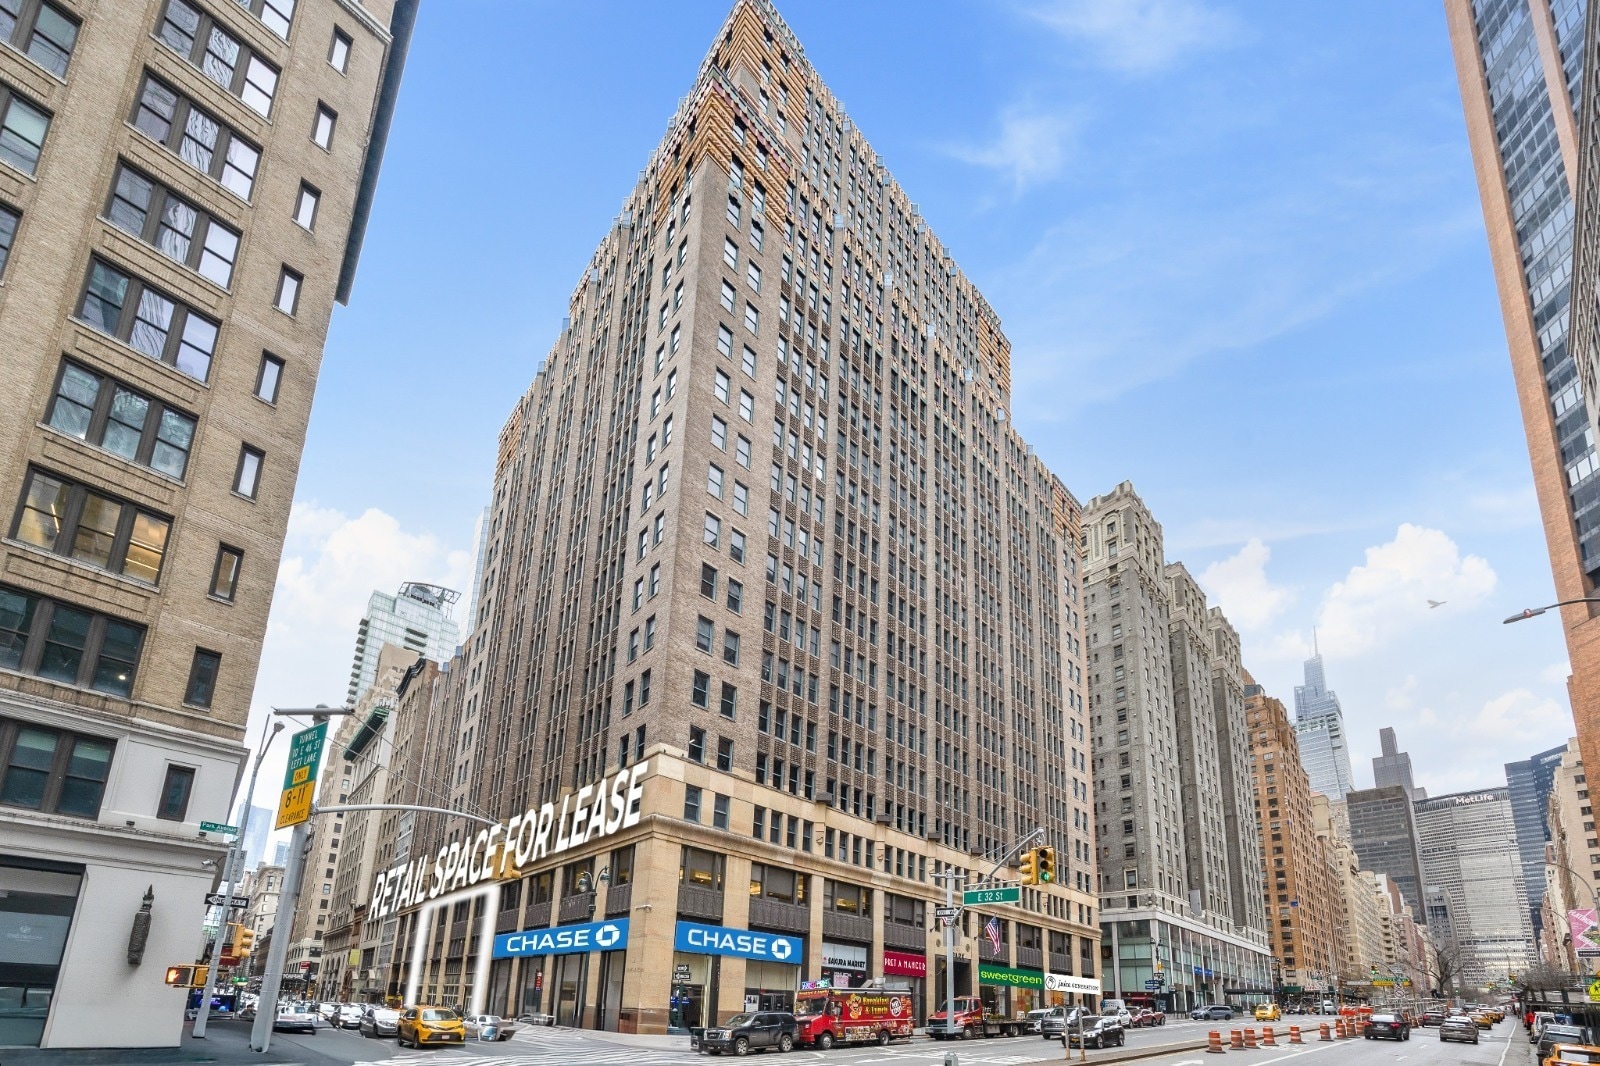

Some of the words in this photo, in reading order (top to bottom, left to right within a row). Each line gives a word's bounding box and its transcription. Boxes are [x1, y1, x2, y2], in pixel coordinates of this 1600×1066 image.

[303, 751, 317, 766] LANE
[294, 769, 308, 782] ONLY
[1455, 793, 1494, 805] MetLife
[202, 821, 215, 829] Park
[216, 824, 237, 833] Avenue
[977, 893, 982, 902] E
[985, 892, 994, 901] 32
[506, 929, 591, 952] CHASE
[687, 929, 767, 955] CHASE
[828, 957, 846, 967] SAKURA
[847, 959, 866, 969] MARKET
[884, 957, 896, 967] PRET
[898, 959, 902, 967] A
[980, 970, 1043, 985] sweetgreen
